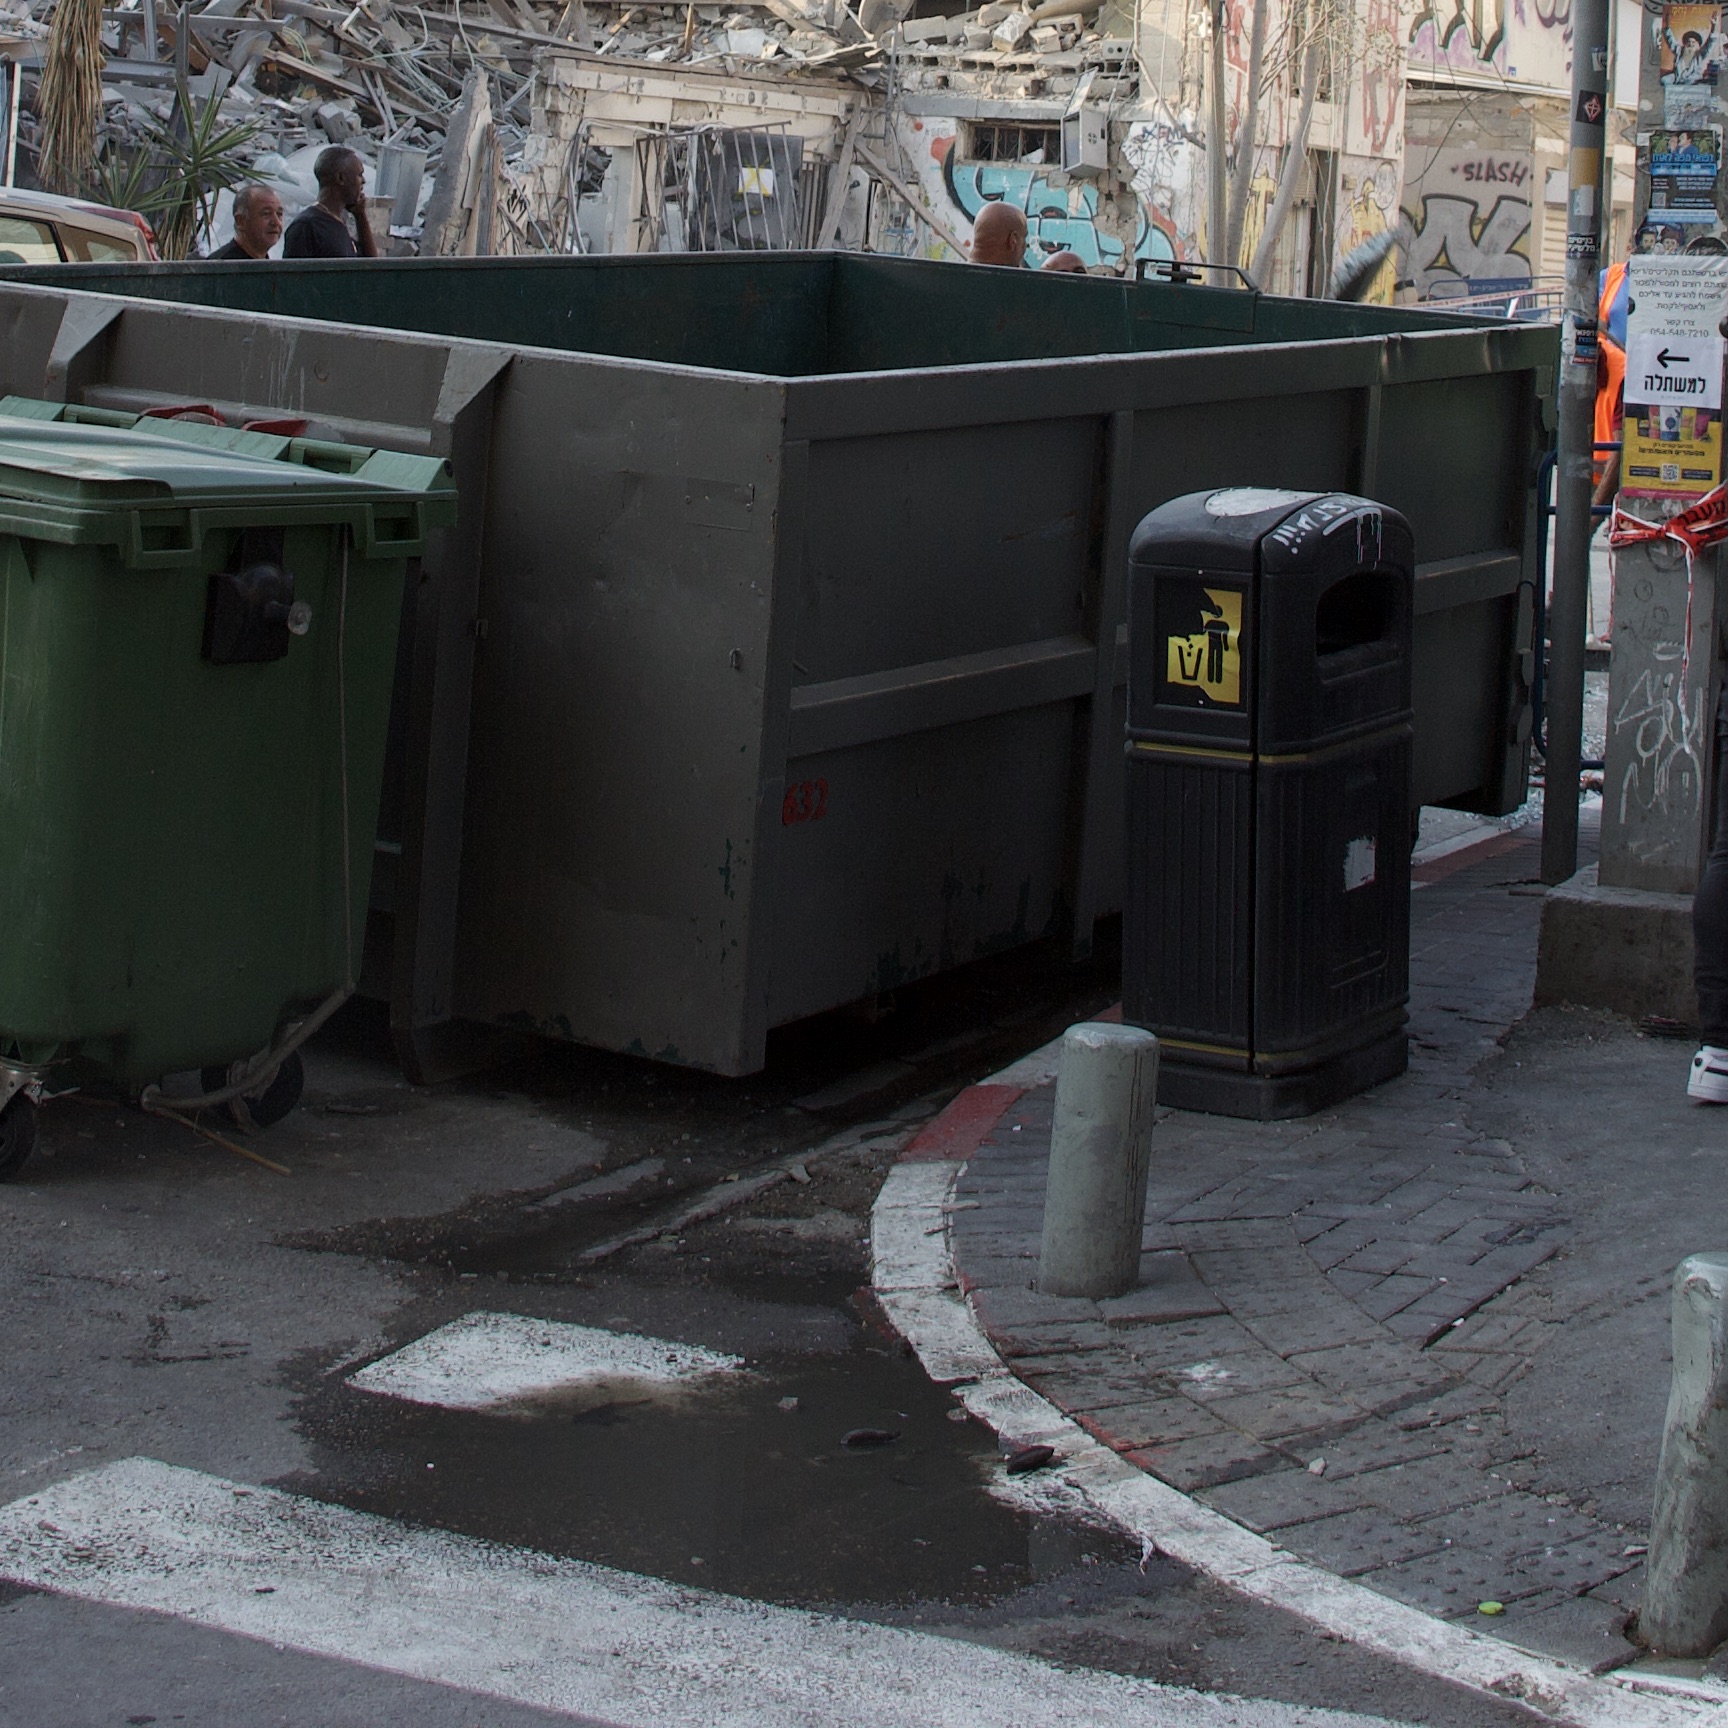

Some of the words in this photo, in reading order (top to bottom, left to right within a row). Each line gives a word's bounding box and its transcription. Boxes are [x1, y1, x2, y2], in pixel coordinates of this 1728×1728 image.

[1463, 156, 1529, 188] SLASH
[1644, 374, 1707, 394] למשתלה
[1677, 497, 1727, 526] מעבר
